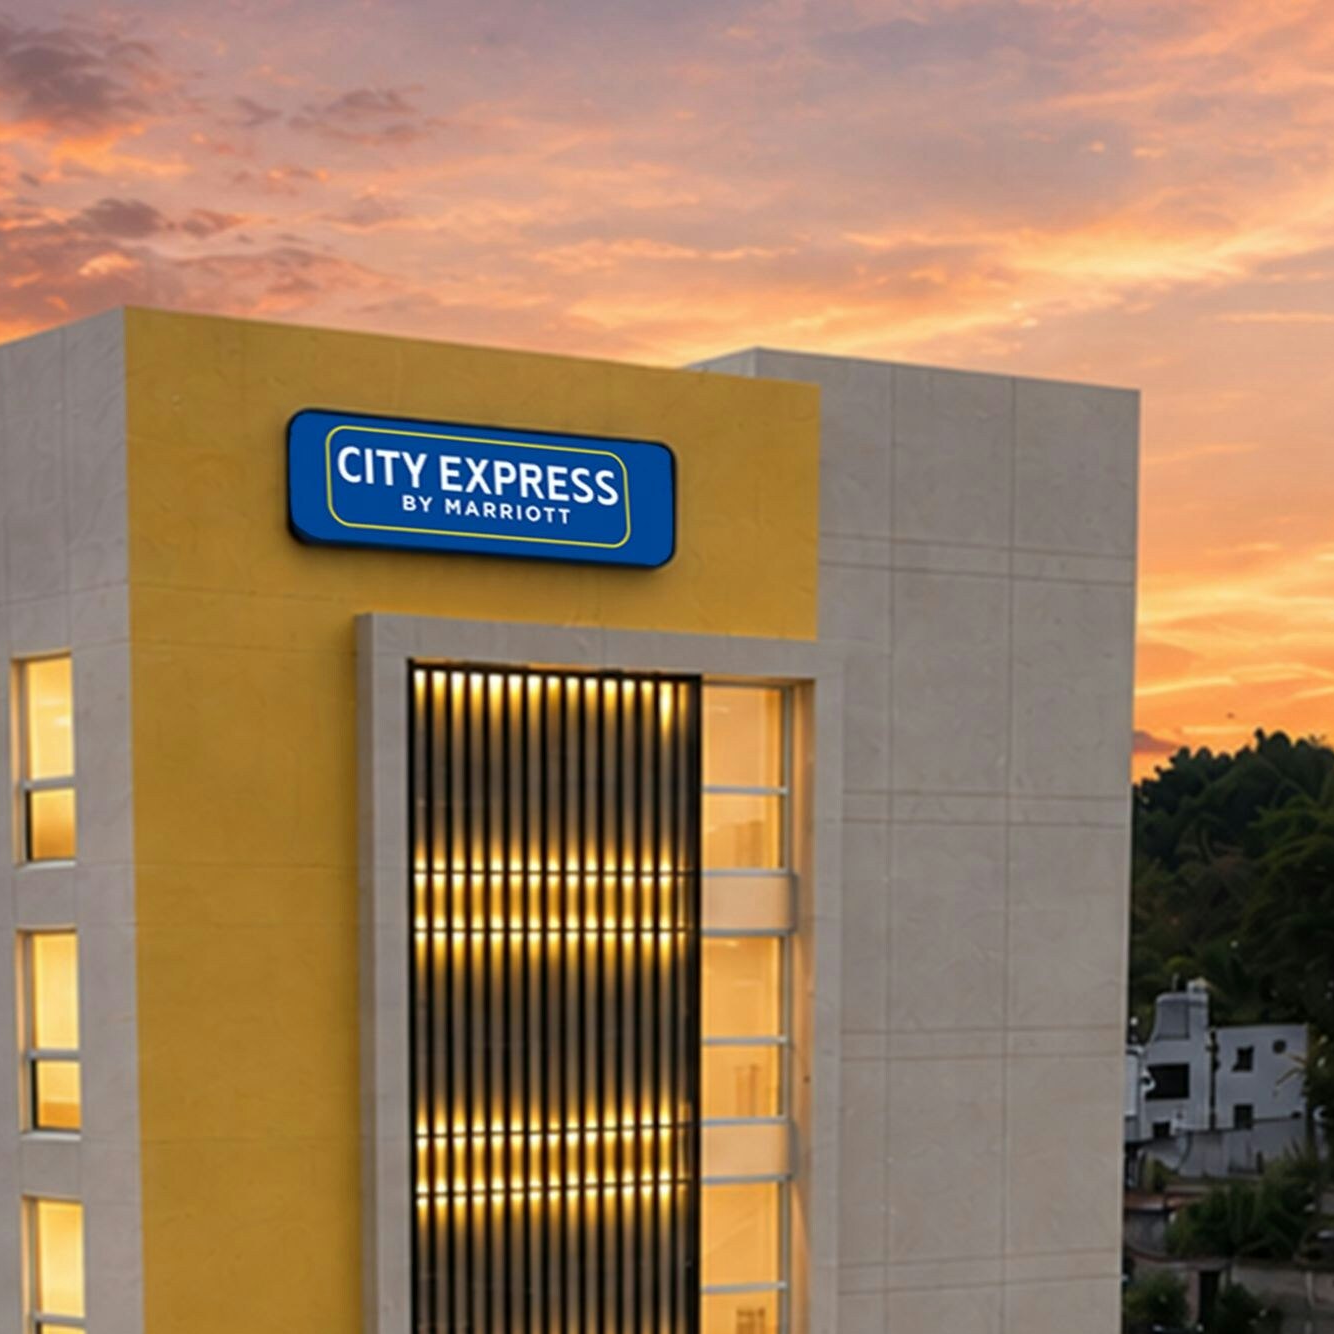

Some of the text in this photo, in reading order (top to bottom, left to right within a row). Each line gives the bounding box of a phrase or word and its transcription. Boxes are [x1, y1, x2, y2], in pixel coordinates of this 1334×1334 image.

[337, 446, 620, 506] CITY EXPRESS
[402, 495, 571, 525] BY MARRIOTT
